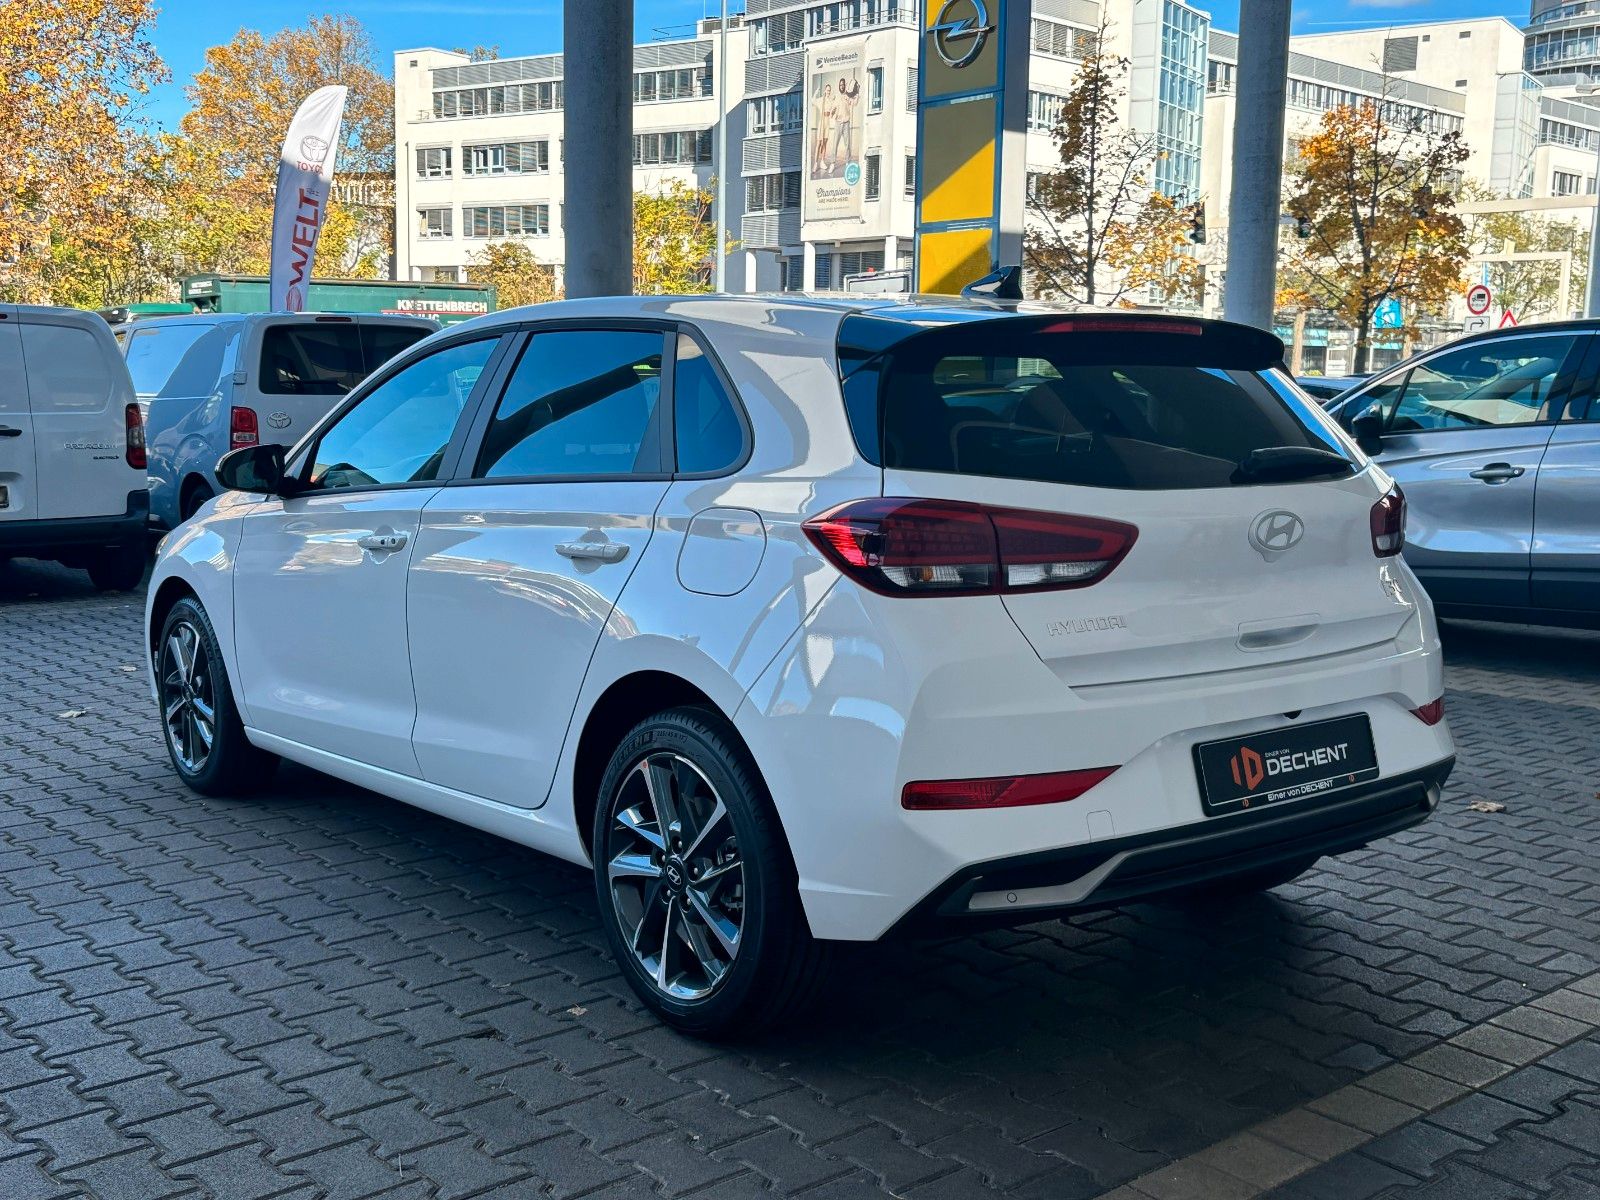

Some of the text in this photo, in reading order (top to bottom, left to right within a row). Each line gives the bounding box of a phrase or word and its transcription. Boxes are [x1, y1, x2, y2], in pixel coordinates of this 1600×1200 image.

[1046, 615, 1127, 637] HYUNDAI
[1266, 743, 1348, 776] DECHENT
[1279, 748, 1290, 756] VON
[1267, 779, 1334, 802] Einer von DECHENT
